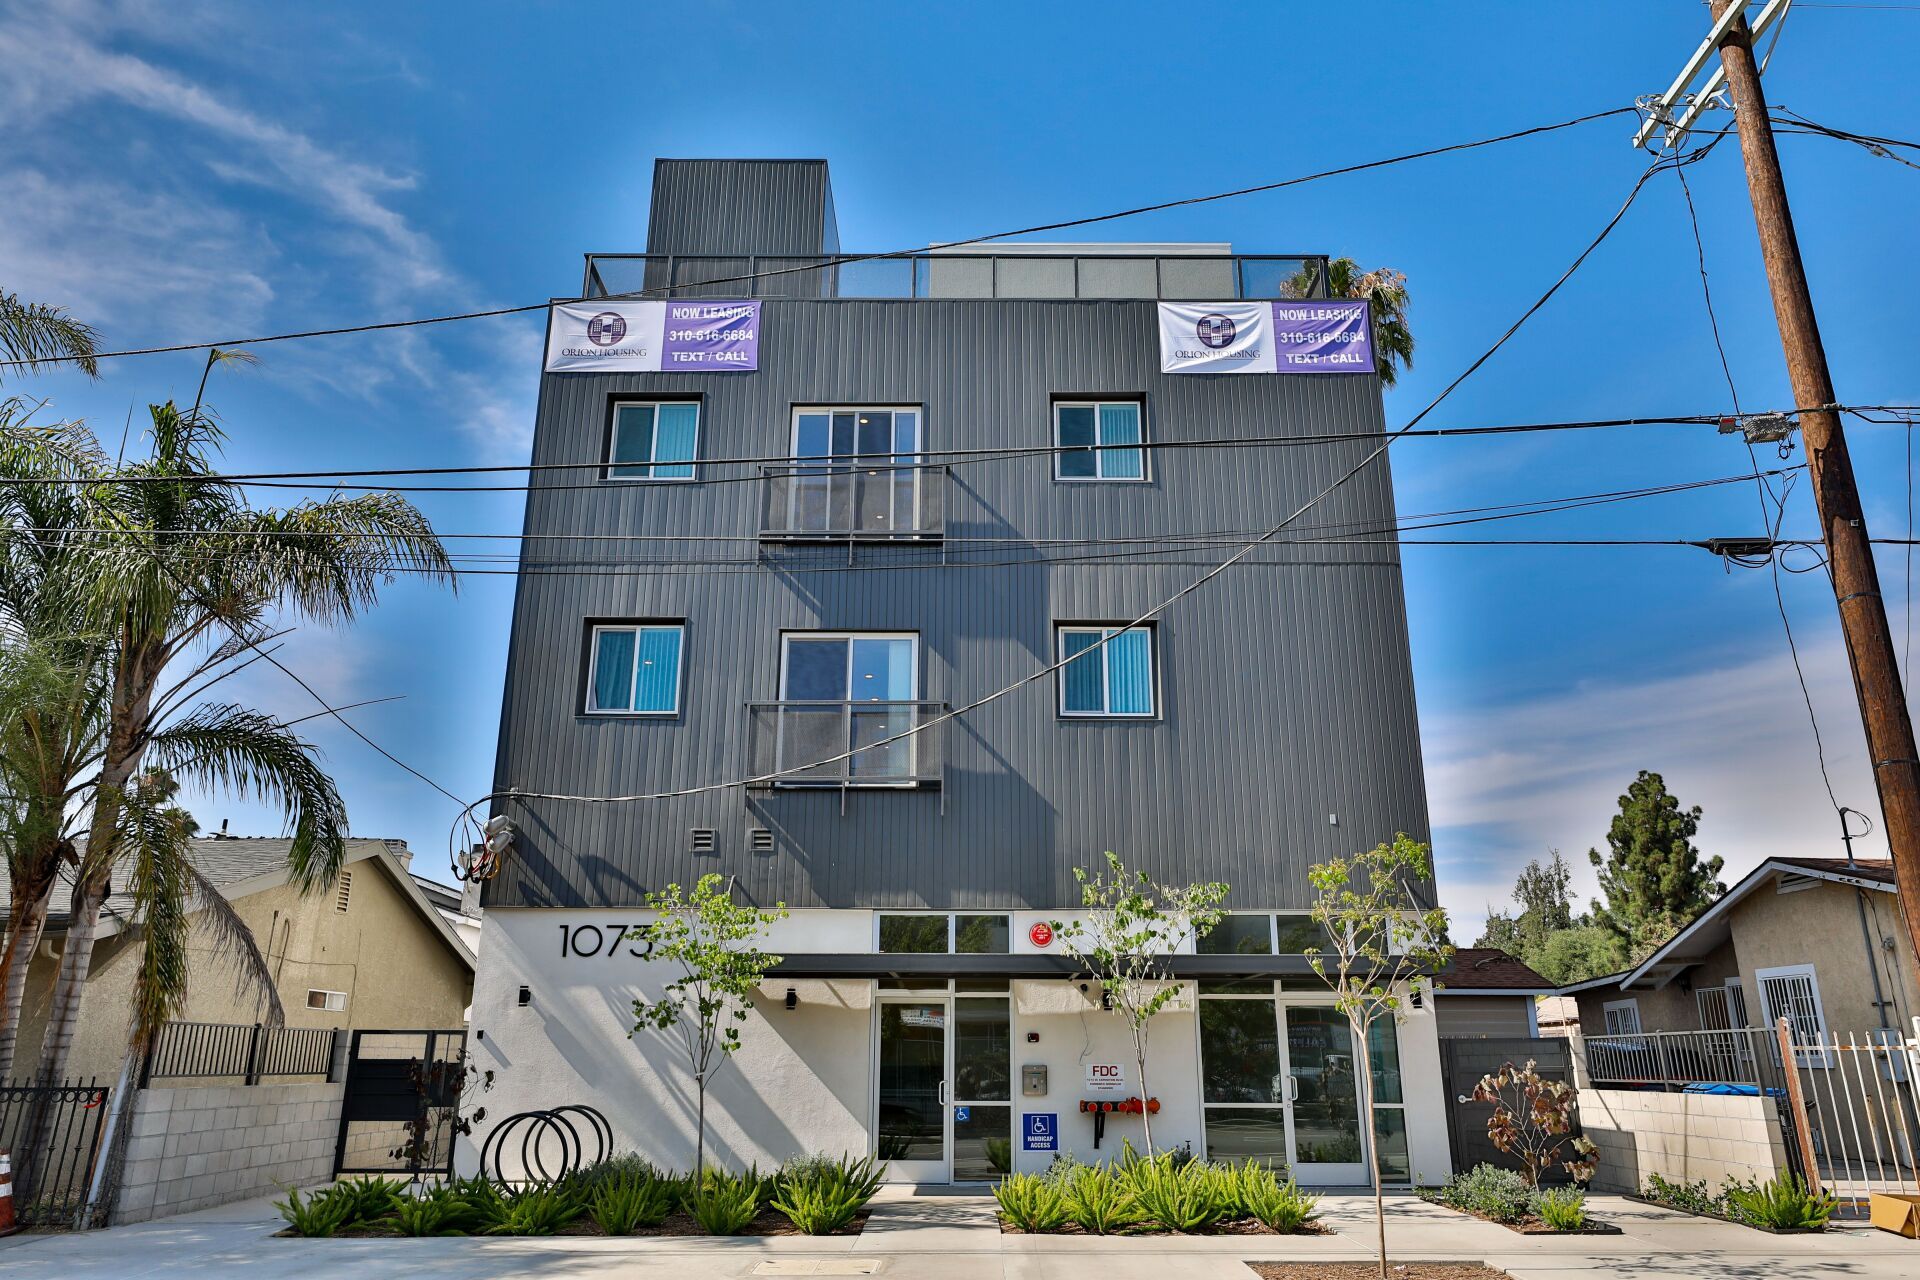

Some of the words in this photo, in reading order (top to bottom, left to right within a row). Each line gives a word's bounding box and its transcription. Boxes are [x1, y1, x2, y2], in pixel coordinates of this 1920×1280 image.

[672, 308, 700, 319] NOW
[704, 305, 755, 318] LEASING
[1280, 309, 1307, 320] NOW
[1311, 308, 1362, 320] LEASING
[669, 330, 754, 341] 310-616-6684
[1281, 332, 1365, 343] 310-616-6684
[562, 348, 597, 357] ORION
[599, 348, 647, 357] HOUSING
[672, 352, 705, 362] TEXT
[715, 352, 748, 361] CALL
[1175, 350, 1209, 359] ORION
[1212, 350, 1260, 359] HOUSING
[1286, 353, 1319, 364] TEXT
[1330, 353, 1363, 363] CALL
[560, 925, 653, 957] 1073
[1092, 1065, 1118, 1076] FDC
